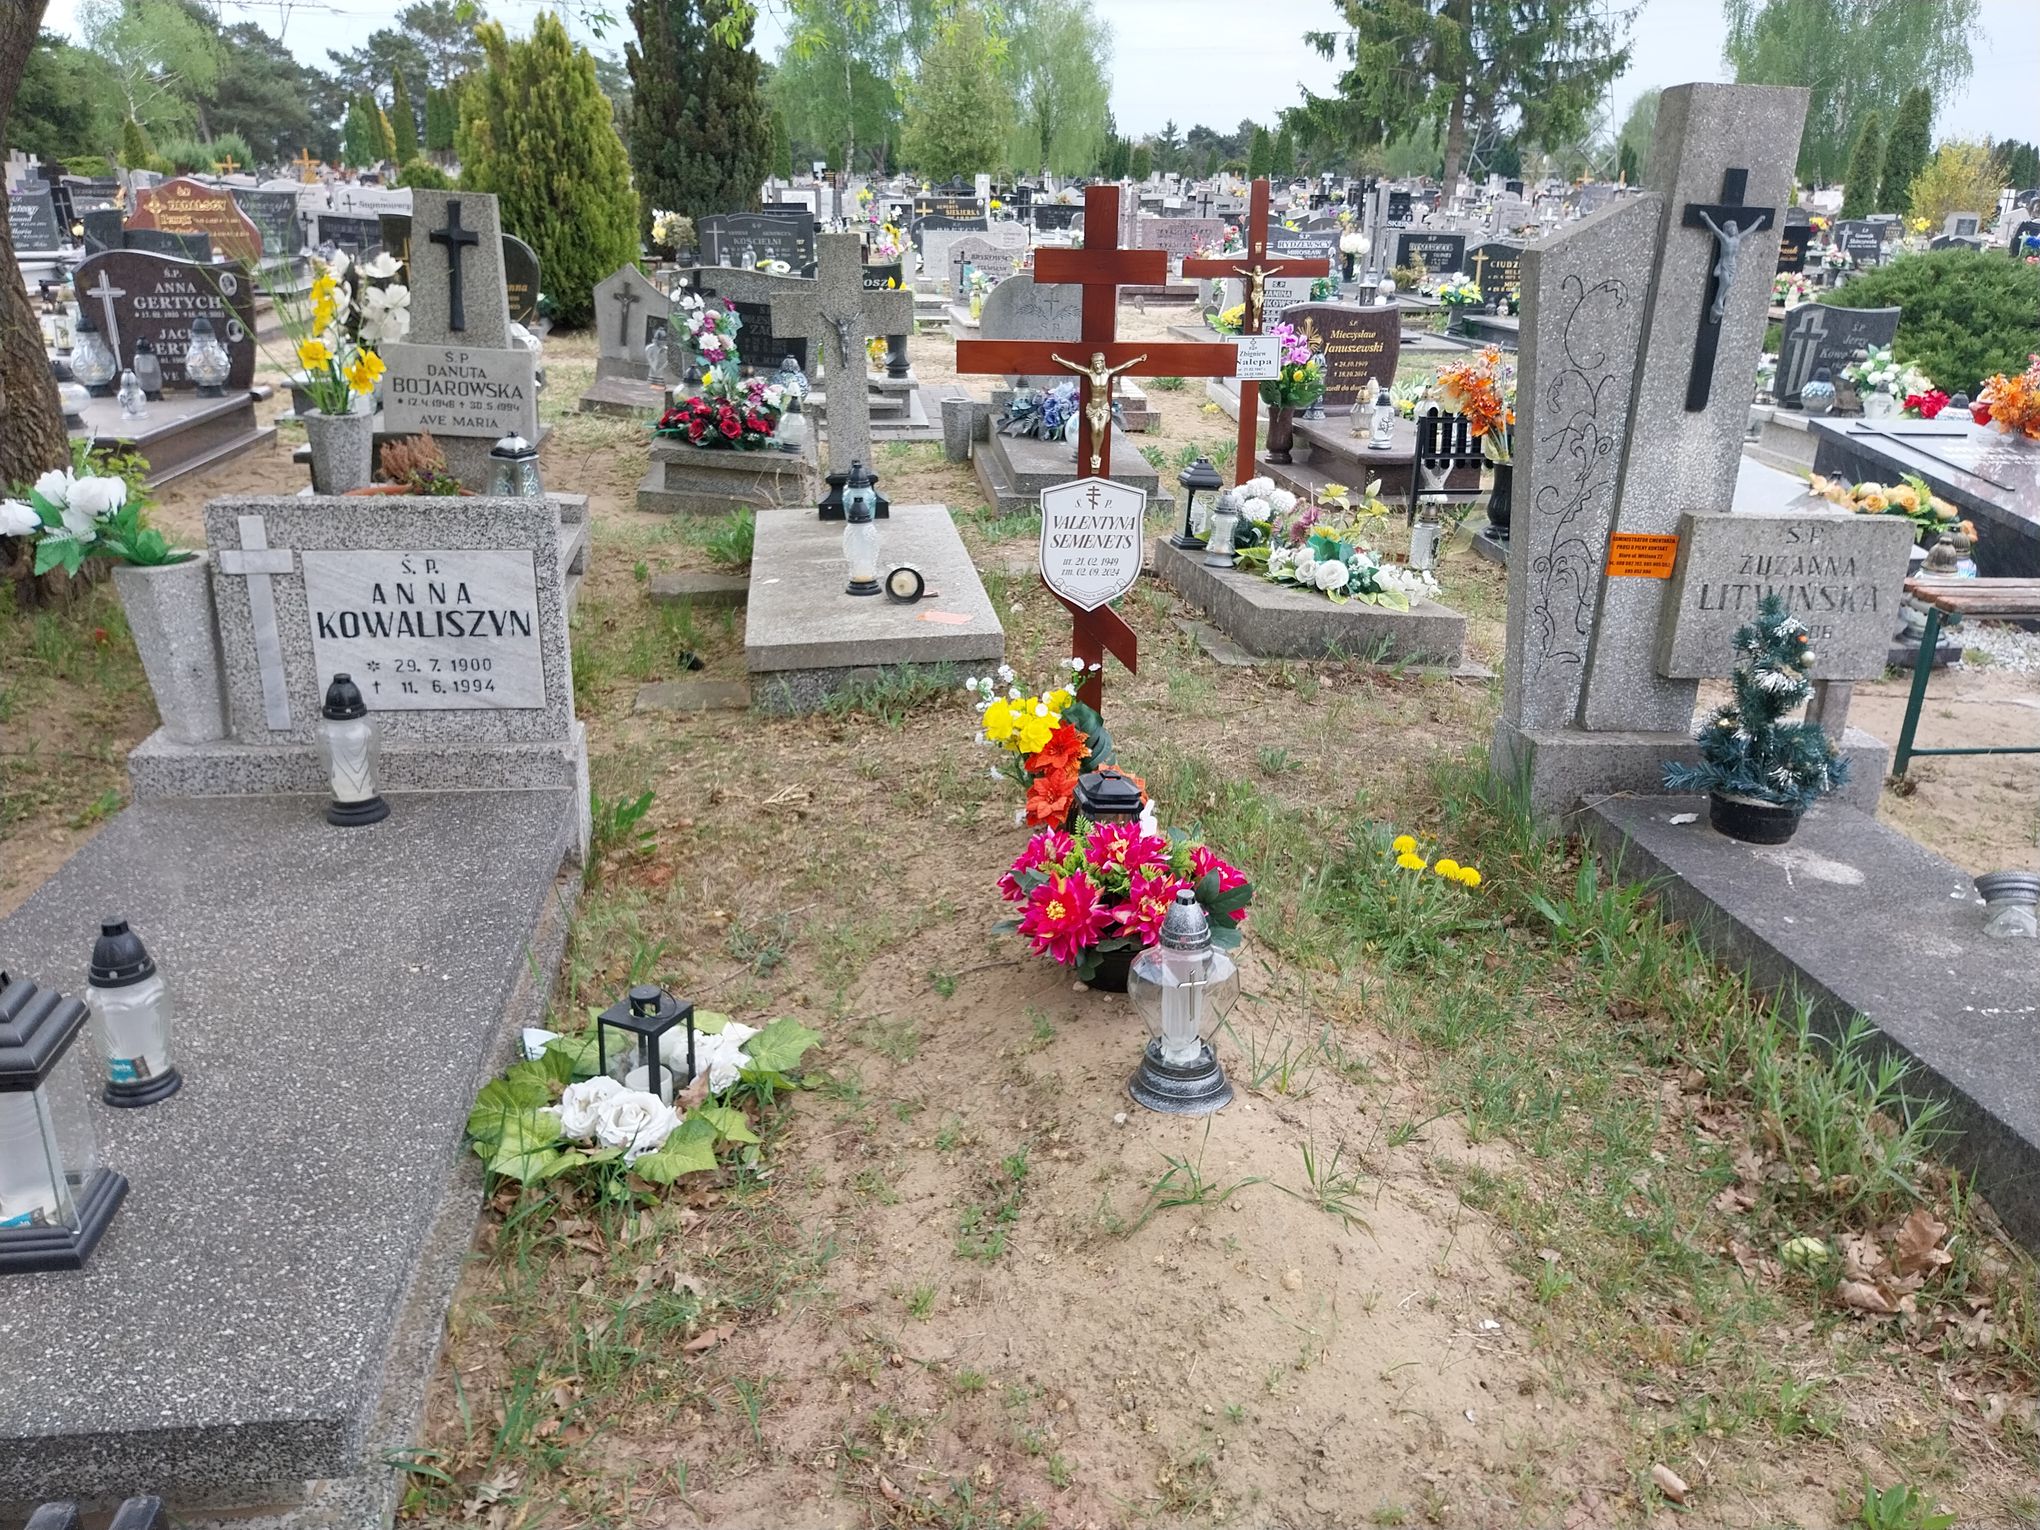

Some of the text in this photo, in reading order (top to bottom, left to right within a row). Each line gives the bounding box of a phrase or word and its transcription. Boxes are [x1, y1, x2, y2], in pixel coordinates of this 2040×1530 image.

[1490, 260, 1520, 269] CIUDZ
[154, 282, 196, 294] ANNA
[133, 296, 224, 310] GERTYCH
[1330, 329, 1376, 341] Mieczysław
[1324, 342, 1384, 356] Januszewski
[427, 364, 487, 379] DANUTA
[393, 377, 523, 400] BOJAROWSKA
[419, 414, 499, 428] AVE MARIA
[1053, 515, 1136, 530] VALENTYNA
[1050, 534, 1134, 549] SEMENETS
[1739, 555, 1856, 577] ZUZANNA
[372, 582, 472, 605] ANNA
[1699, 582, 1878, 613] LITWIŃSKA
[317, 610, 532, 639] KOWALISZYN
[394, 658, 492, 673] 29. 7. 1900
[402, 679, 495, 694] 11. 6. 1994
